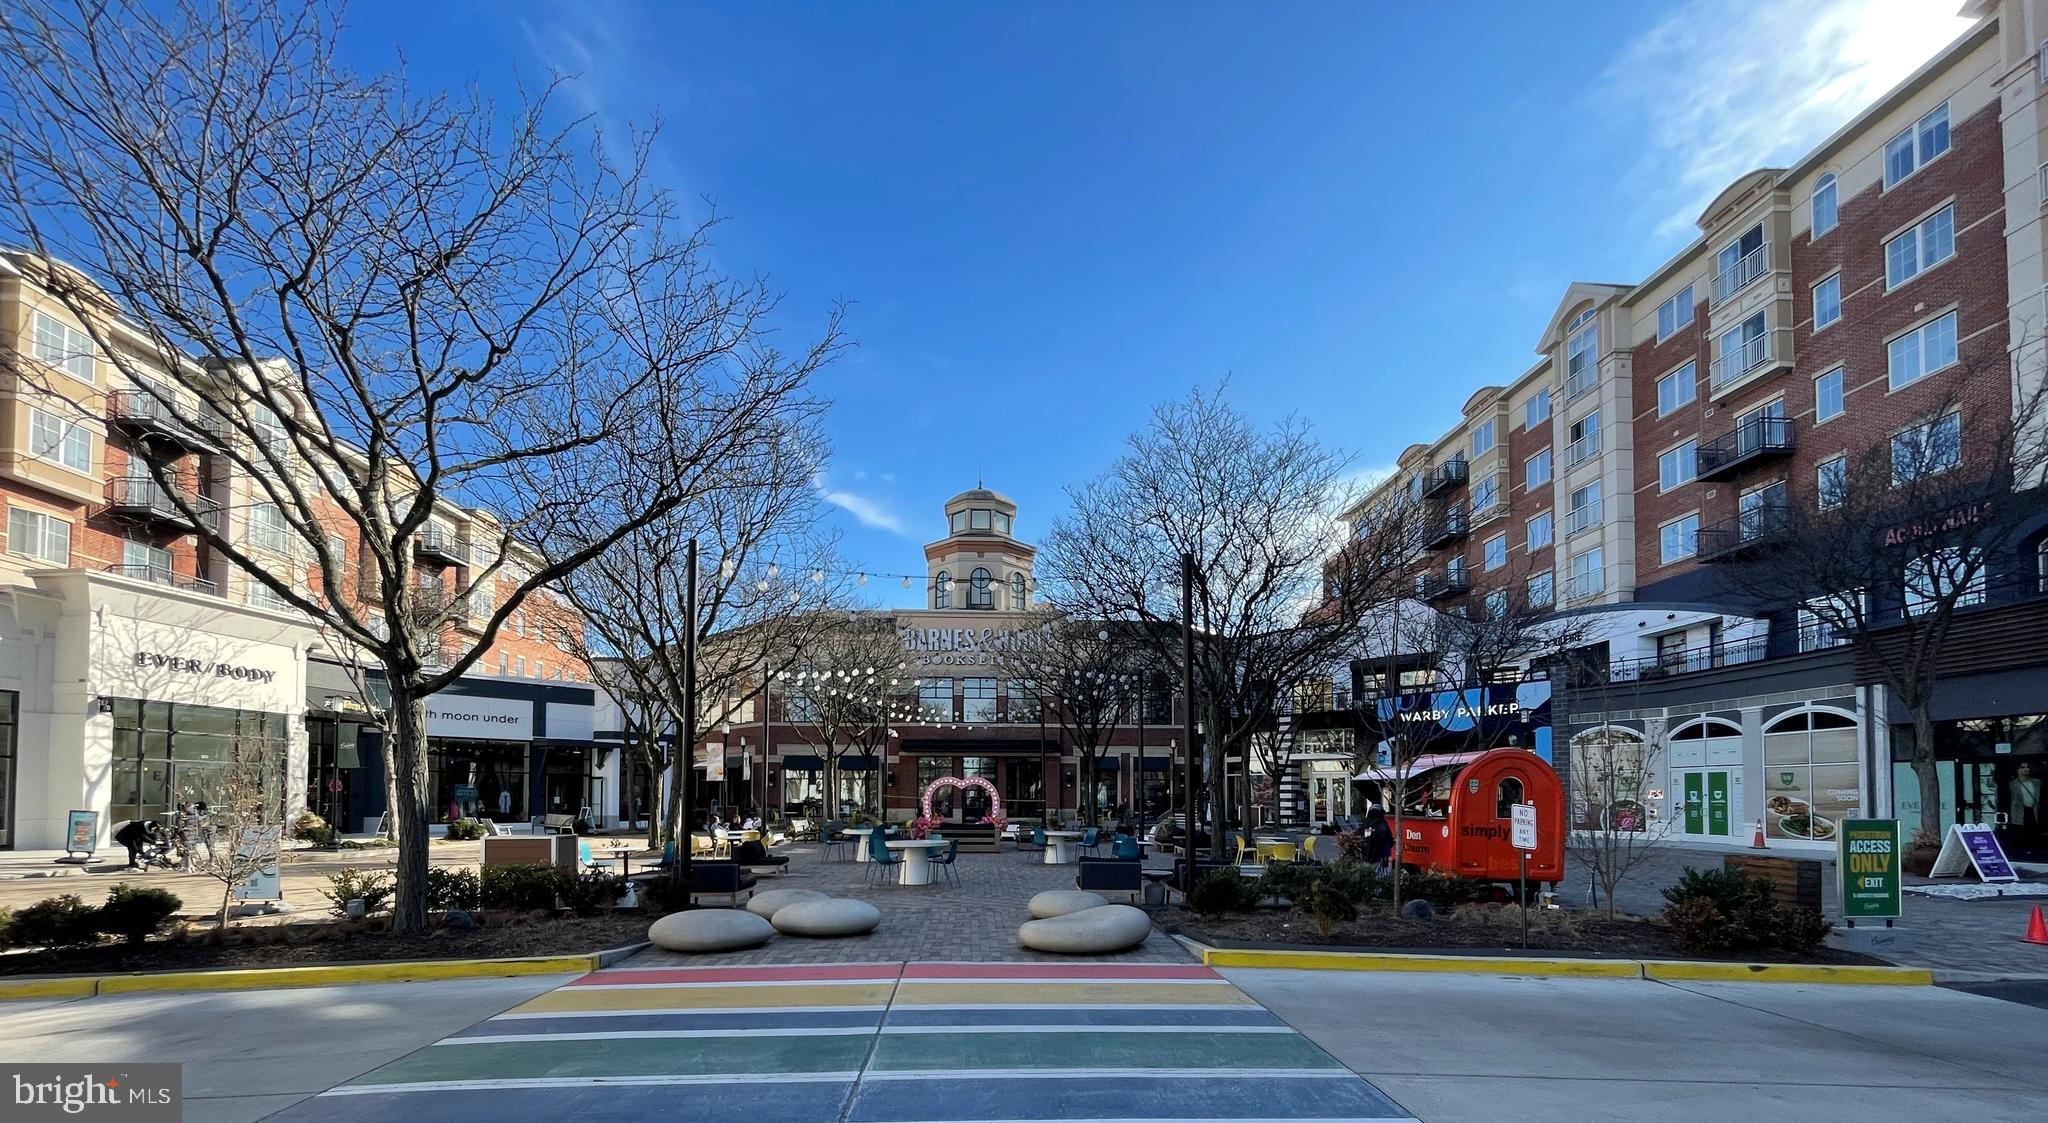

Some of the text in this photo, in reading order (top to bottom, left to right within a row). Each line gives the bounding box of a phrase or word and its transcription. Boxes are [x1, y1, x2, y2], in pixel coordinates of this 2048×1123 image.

[902, 628, 975, 652] BARNES
[978, 627, 993, 651] &
[442, 712, 479, 722] moon
[483, 710, 519, 724] under
[1401, 709, 1450, 722] WARBY
[1519, 809, 1529, 818] NO
[1514, 817, 1534, 827] PARKING
[1406, 829, 1422, 841] Don
[1461, 823, 1511, 842] simply
[1519, 836, 1530, 844] TIME
[1849, 840, 1891, 853] ACCESS
[1850, 854, 1890, 873] ONLY
[1864, 877, 1884, 888] EXIT
